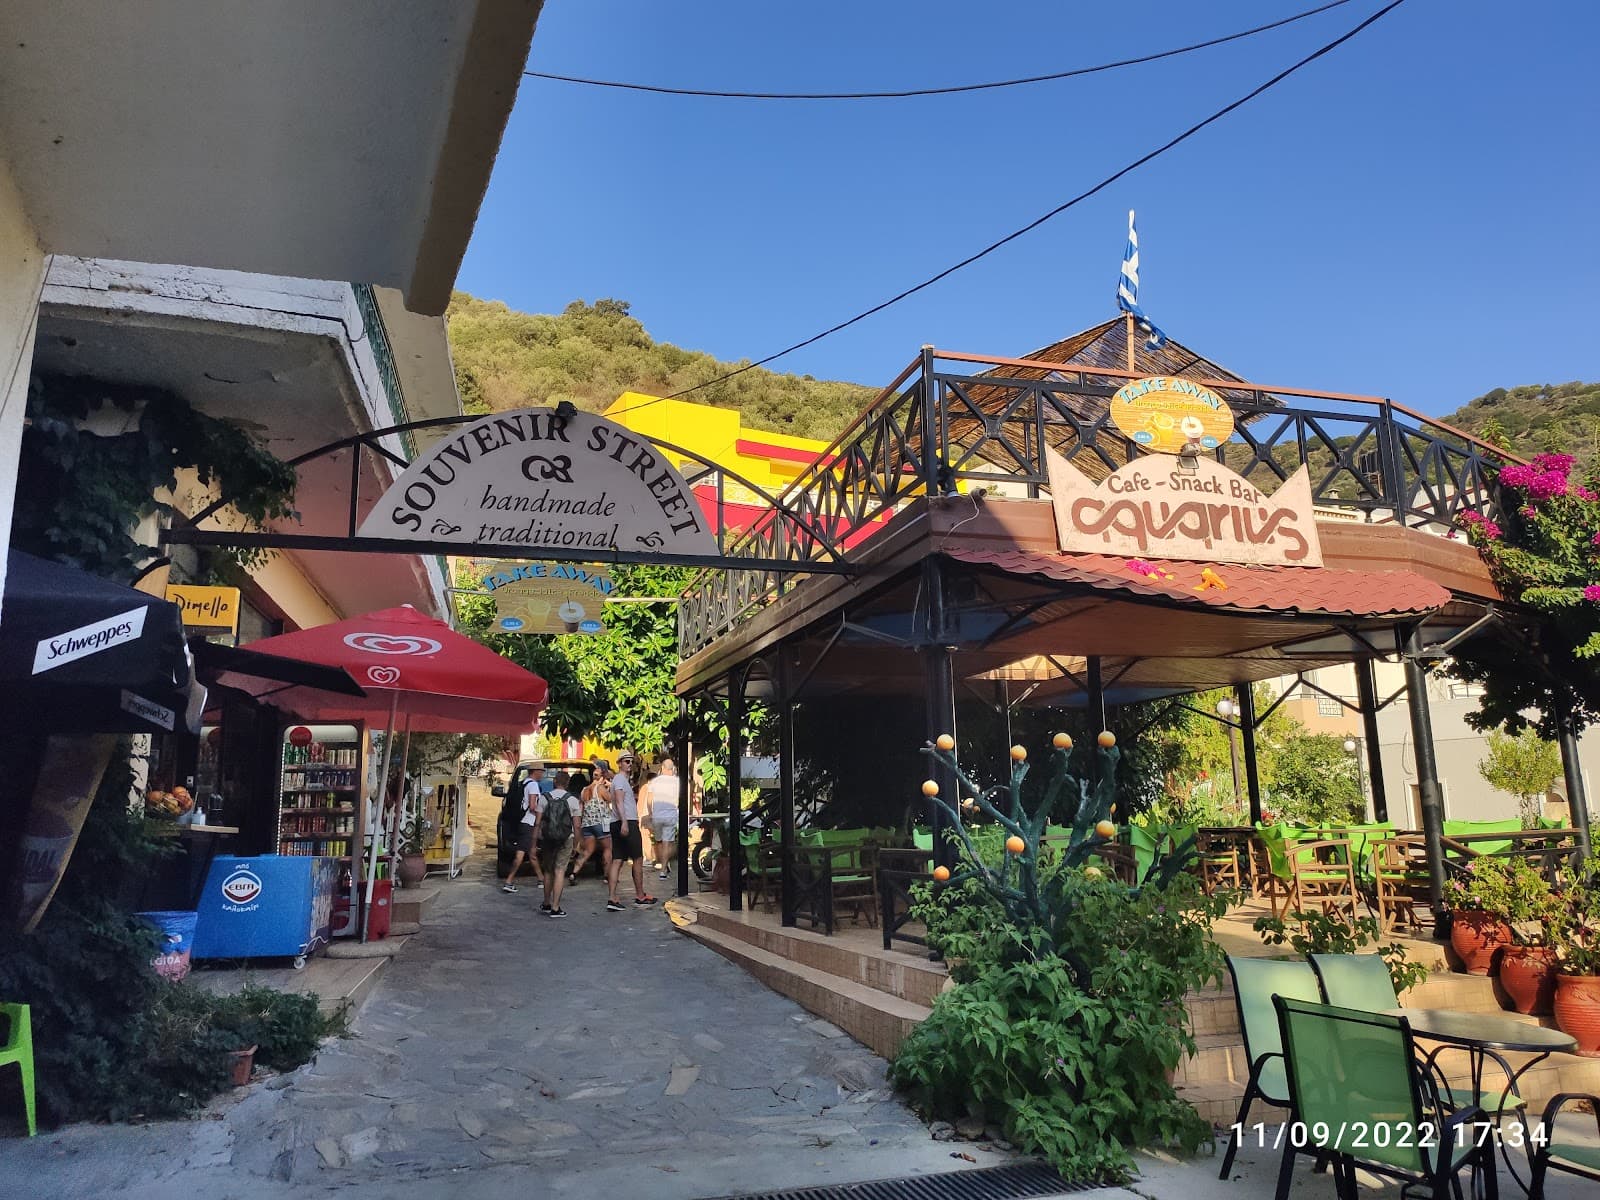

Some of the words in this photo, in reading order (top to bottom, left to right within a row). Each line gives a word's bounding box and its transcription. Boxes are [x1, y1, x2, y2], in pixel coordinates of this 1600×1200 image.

[1119, 378, 1169, 404] TAKE
[1171, 380, 1225, 411] AWAY
[392, 413, 571, 532] SOUVENIR
[587, 425, 701, 536] STREET
[1107, 472, 1151, 494] Cafe
[1169, 471, 1224, 495] Snack
[1230, 479, 1260, 504] Bar
[480, 485, 616, 517] handmade
[477, 519, 618, 547] traditional
[482, 563, 548, 591] TAKE
[550, 564, 617, 595] AWAY
[173, 593, 228, 618] Dimello
[47, 621, 133, 660] Schweppes
